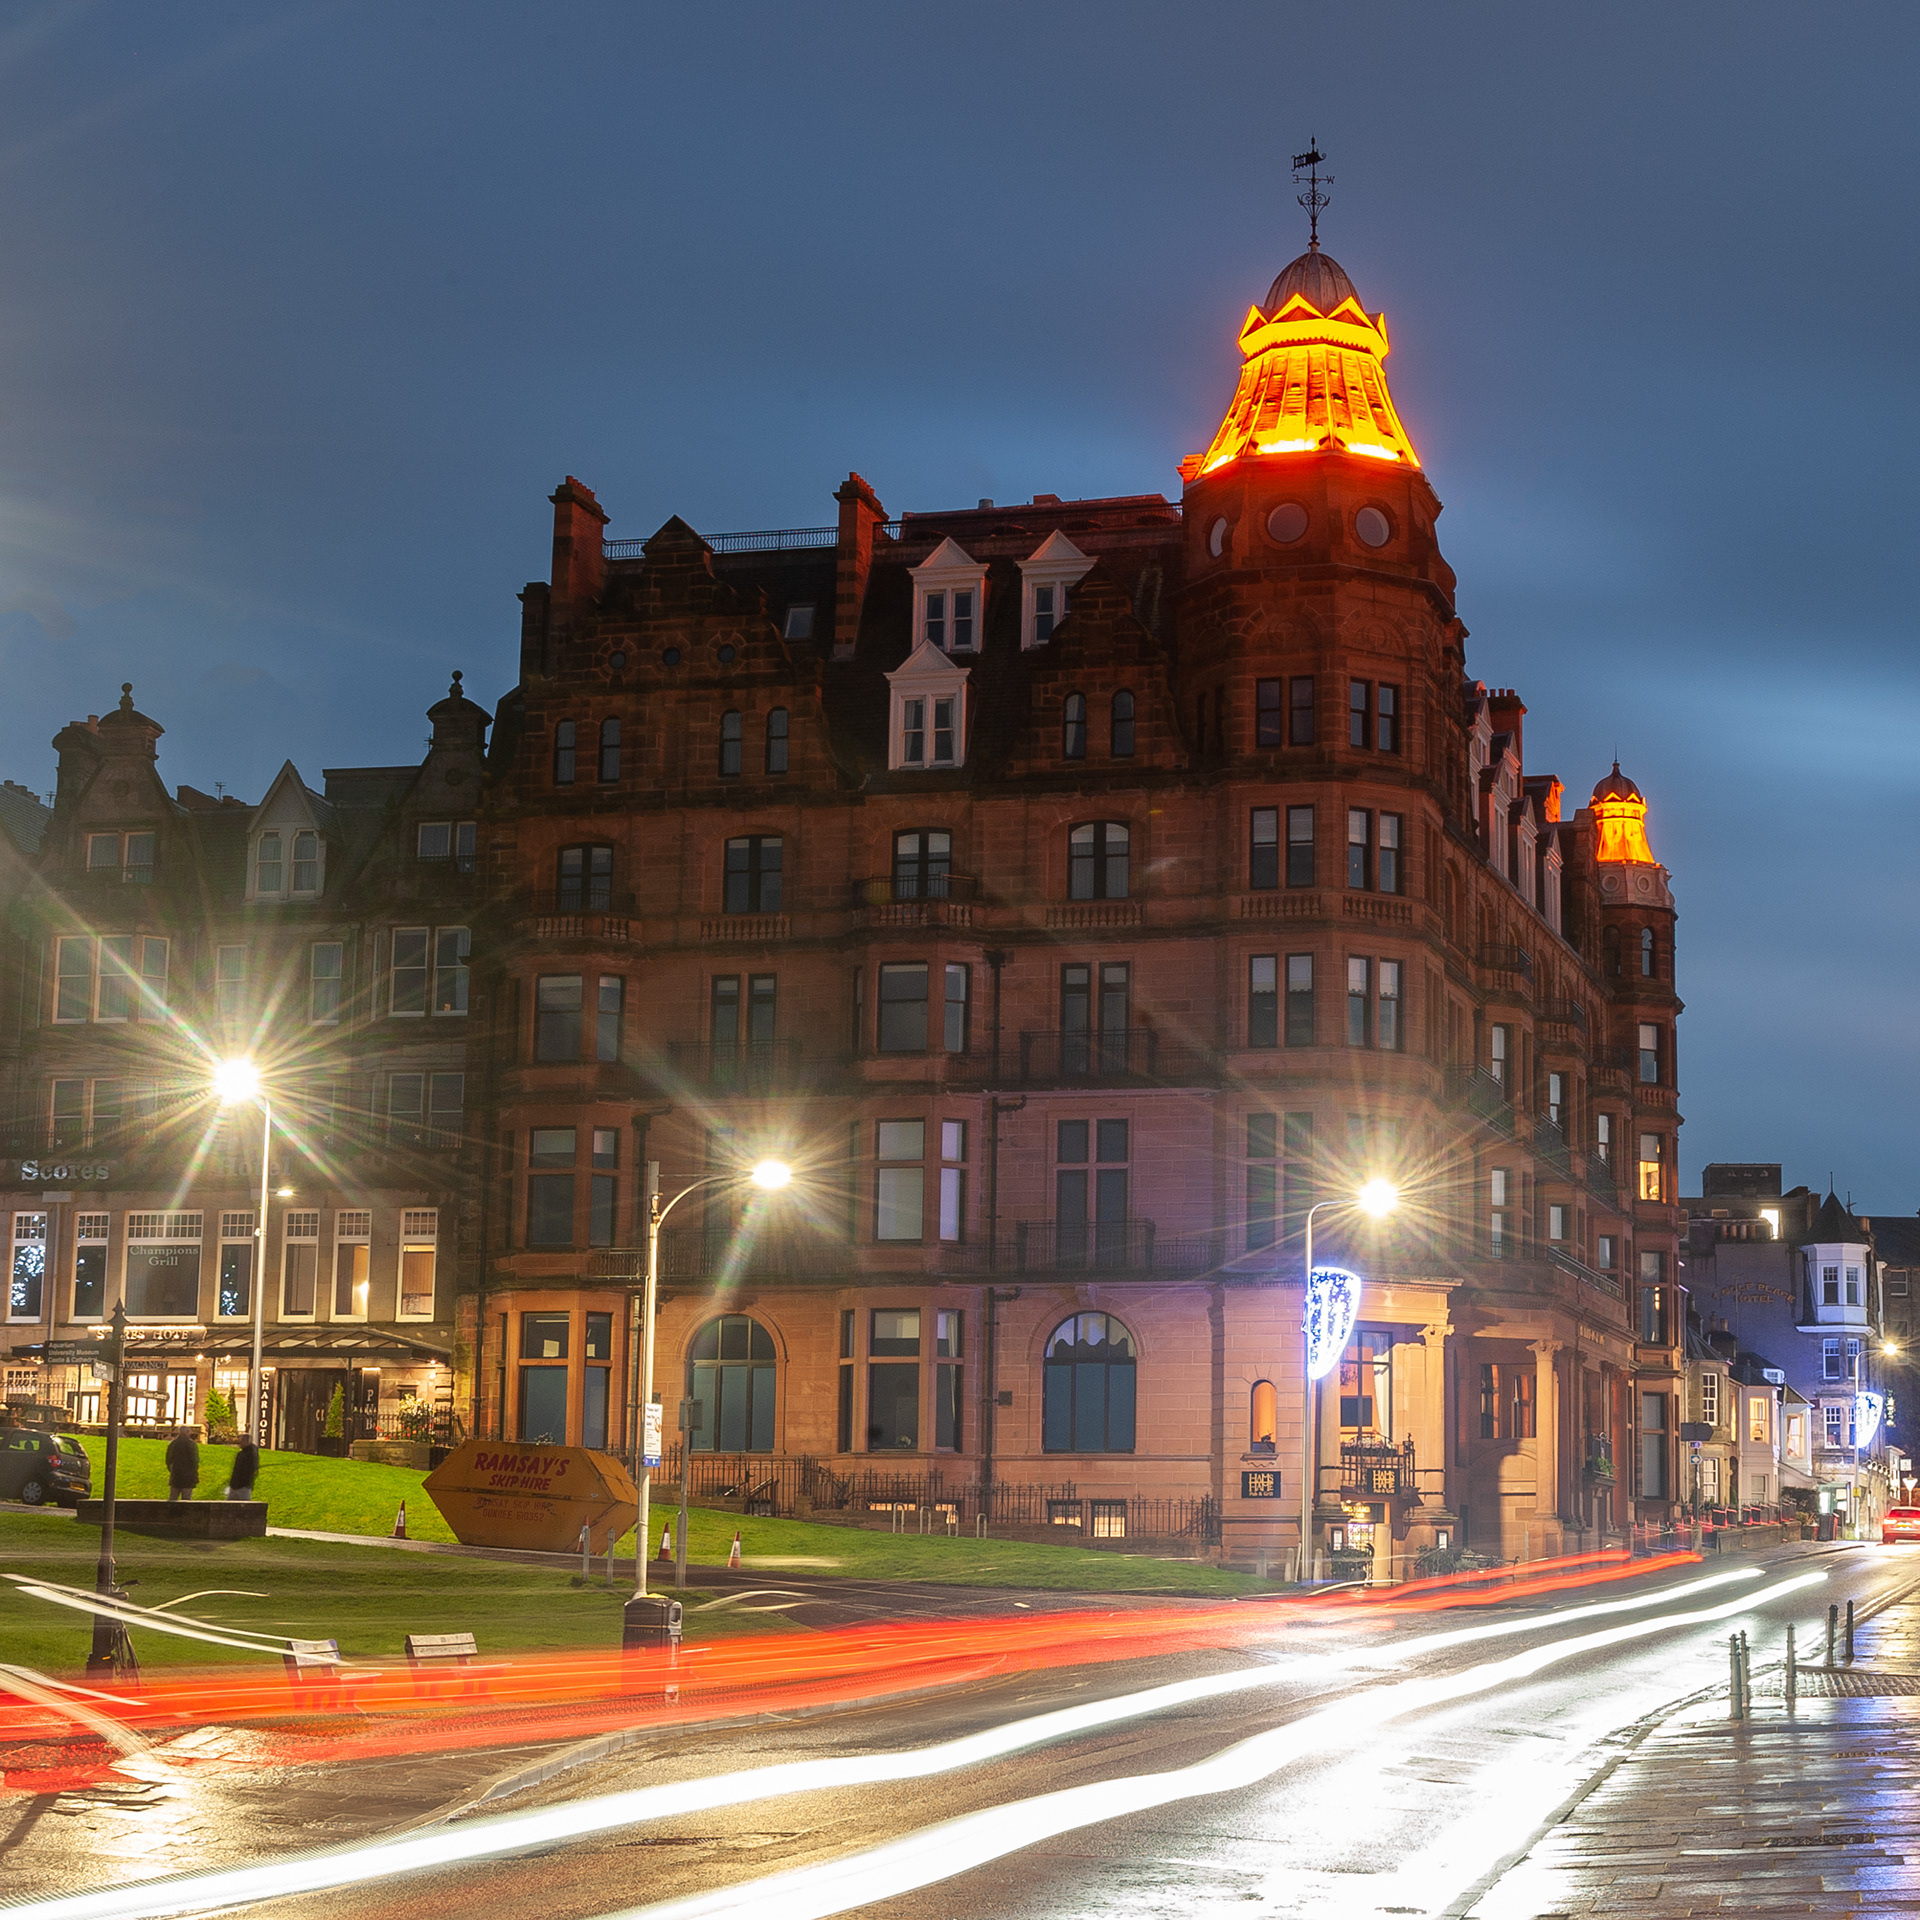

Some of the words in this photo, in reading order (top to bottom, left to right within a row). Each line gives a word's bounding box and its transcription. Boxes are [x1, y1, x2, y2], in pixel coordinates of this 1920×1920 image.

[21, 1160, 109, 1181] Scores
[215, 1156, 291, 1177] Hotel
[129, 1246, 199, 1256] Champions
[148, 1256, 178, 1266] Grill
[1721, 1282, 1754, 1297] GOLF
[1757, 1282, 1795, 1304] PLACE
[260, 1372, 270, 1447] CHARIOTS
[365, 1389, 375, 1431] PUB
[474, 1452, 570, 1477] RAMSAY'S
[488, 1474, 519, 1488] SKIP
[520, 1476, 552, 1491] HIRE
[513, 1500, 531, 1509] SKIP
